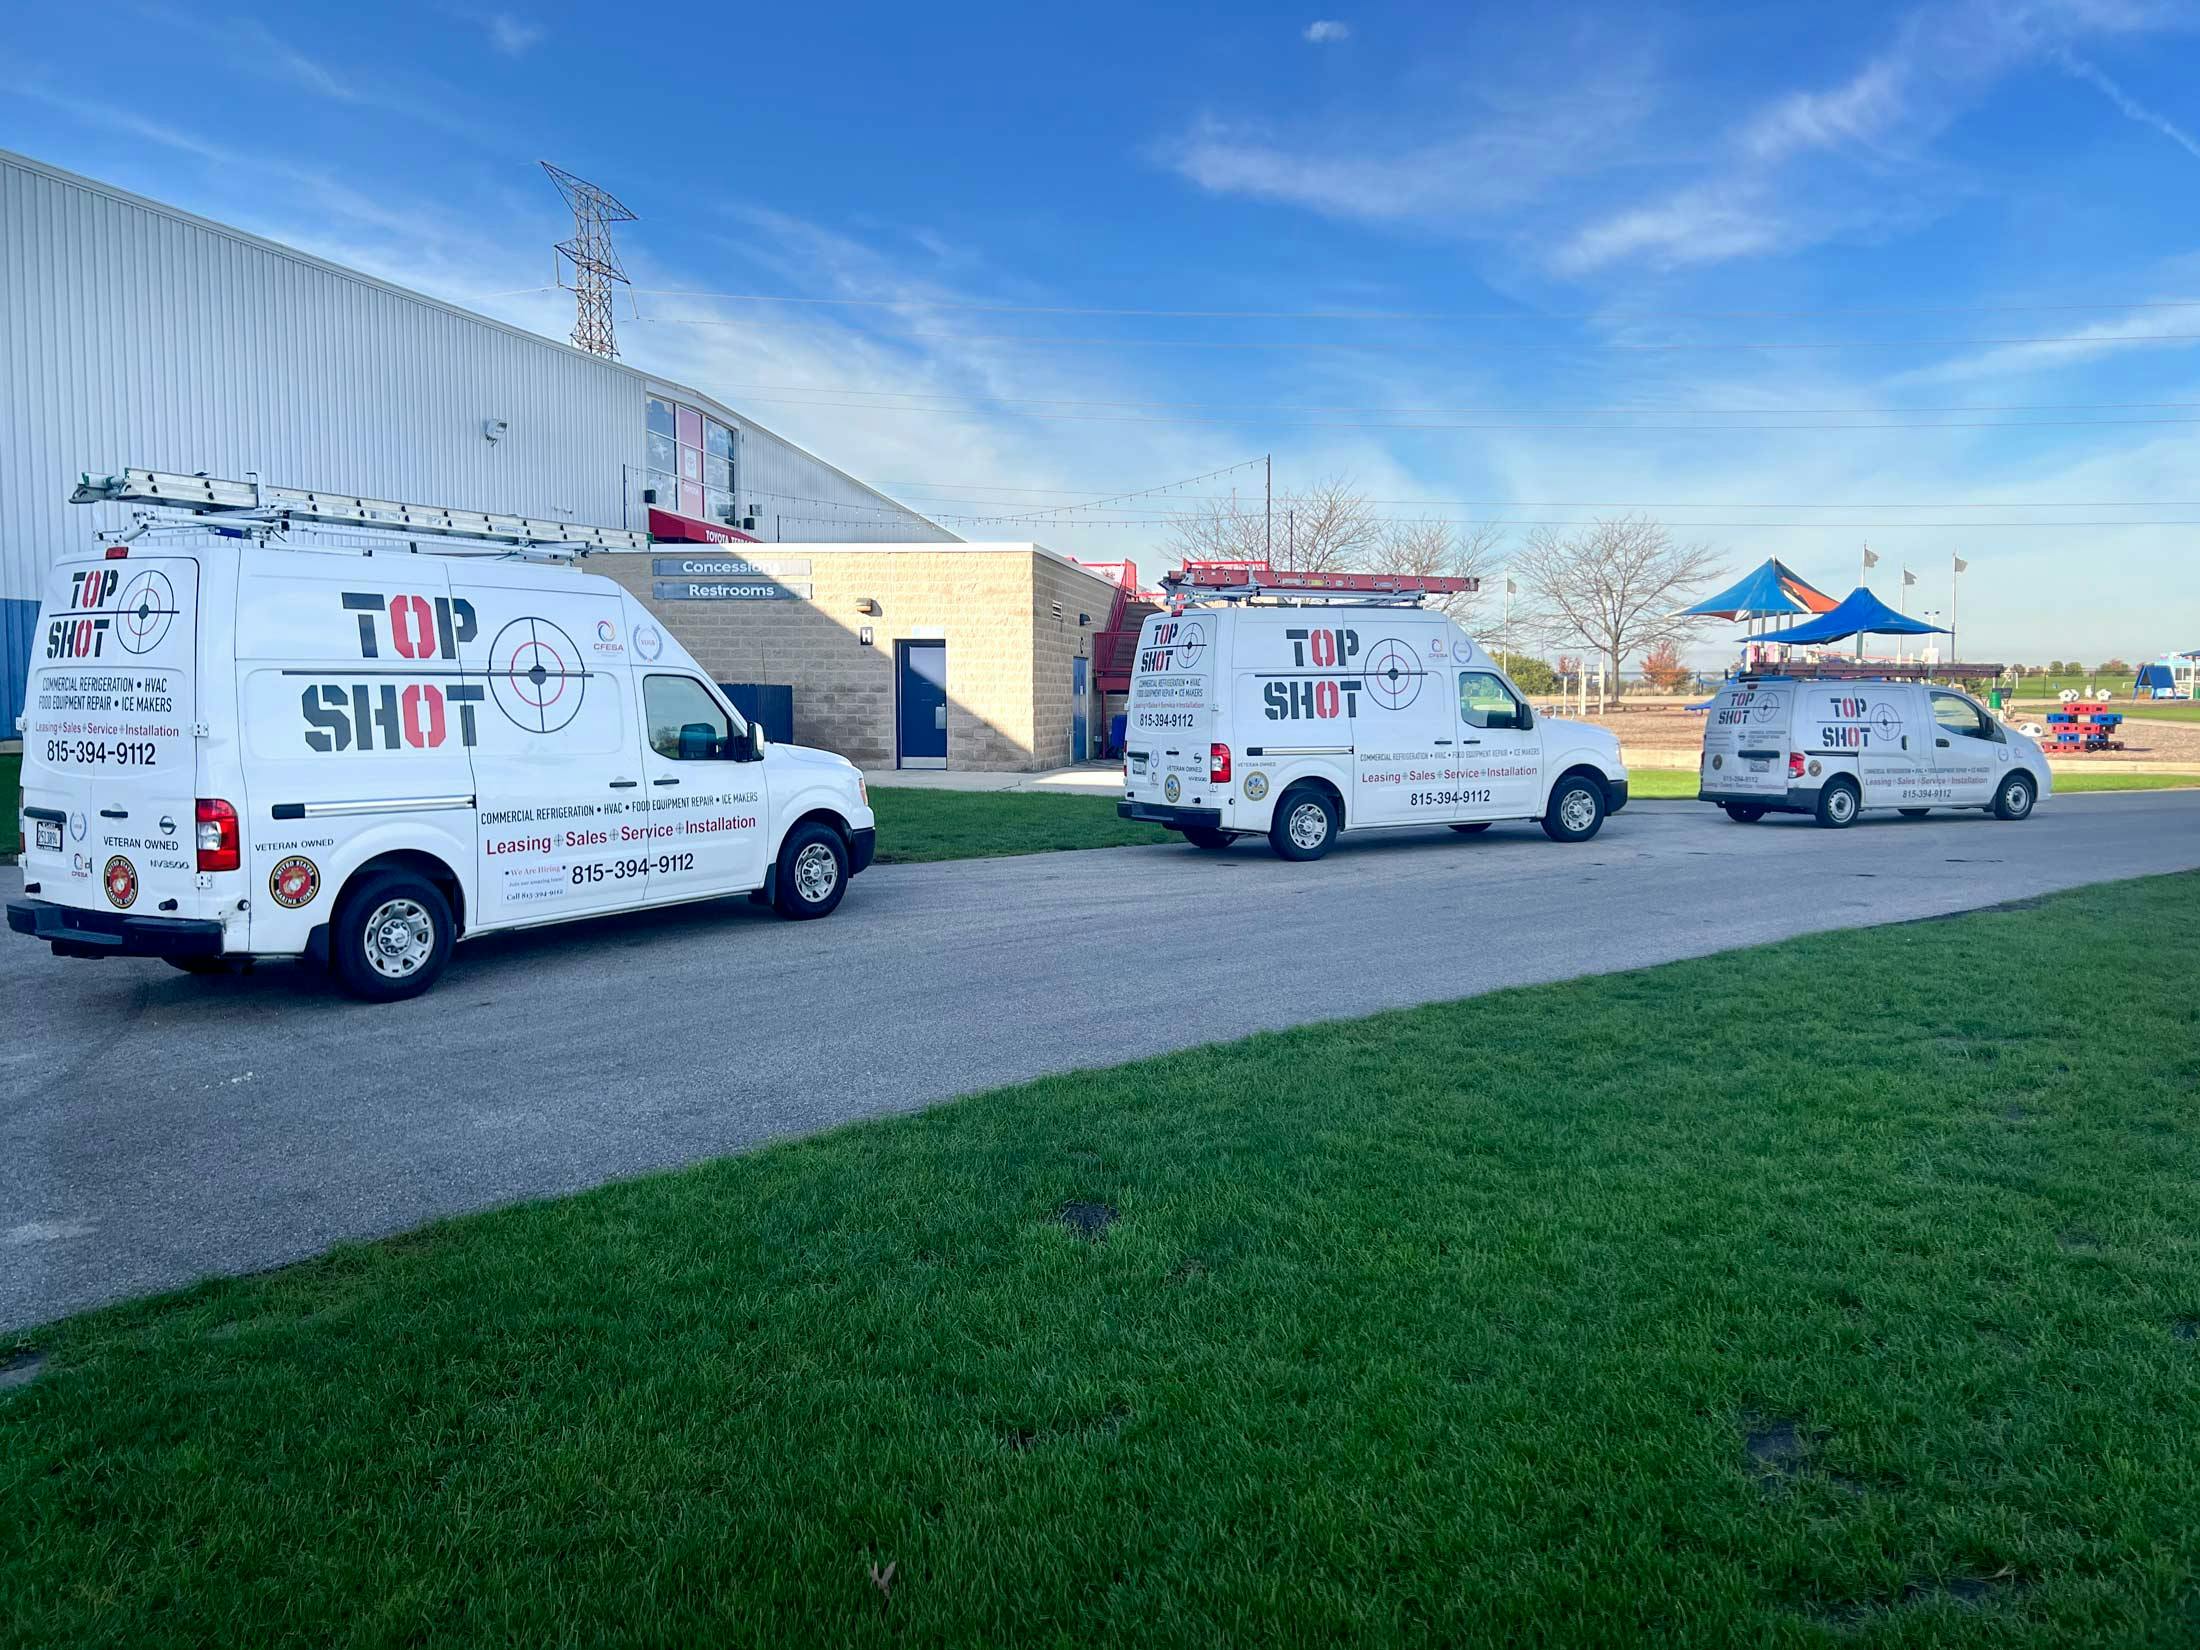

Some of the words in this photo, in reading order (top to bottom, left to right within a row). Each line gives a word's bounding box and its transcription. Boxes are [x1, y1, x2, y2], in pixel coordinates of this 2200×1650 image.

[705, 530, 729, 544] TOYOTA
[71, 569, 119, 609] TOP
[689, 584, 775, 596] Restrooms
[341, 591, 479, 660] TOP
[1153, 623, 1179, 645] TOP
[46, 619, 110, 659] SHOT
[861, 629, 872, 643] H
[1285, 629, 1360, 667] TOP
[1141, 650, 1174, 673] SHOT
[79, 677, 134, 692] REFRIGERATION
[145, 678, 168, 693] HVAC
[53, 695, 86, 710] EQUIPMENT
[87, 696, 112, 711] REPAIR
[121, 697, 134, 711] ICE
[136, 697, 172, 712] MAKERS
[1264, 680, 1362, 720] SHOT
[1731, 692, 1755, 706] TOP
[1830, 697, 1867, 718] TOP
[301, 683, 486, 752] SHOT
[1140, 713, 1194, 727] 815-394-9112
[1718, 710, 1750, 725] SHOT
[63, 721, 82, 733] Sales
[87, 722, 118, 735] Service
[125, 724, 180, 737] Installation
[1822, 727, 1871, 747] SHOT
[47, 739, 156, 765] 815-394-9112
[1362, 772, 1401, 784] Leasing
[1409, 770, 1436, 781] Sales
[1444, 768, 1479, 779] Service
[1487, 766, 1537, 777] Installation
[1410, 789, 1491, 806] 815-394-9112
[481, 809, 535, 825] COMMERCIAL
[536, 805, 594, 820] REFRIGERATION
[604, 802, 623, 815] HVAC
[632, 801, 650, 812] FOOD
[652, 797, 690, 811] EQUIPMENT
[691, 795, 714, 807] REPAIR
[721, 793, 732, 805] ICE
[733, 792, 758, 804] MAKERS
[103, 836, 141, 849] VETERAN
[144, 839, 179, 851] OWNED
[255, 841, 298, 852] VETERAN
[301, 838, 334, 849] OWNED
[487, 835, 551, 855] Leasing
[566, 829, 607, 847] Sales
[621, 823, 673, 841] Service
[686, 815, 756, 834] Installation
[572, 852, 694, 885] 815-394-9112
